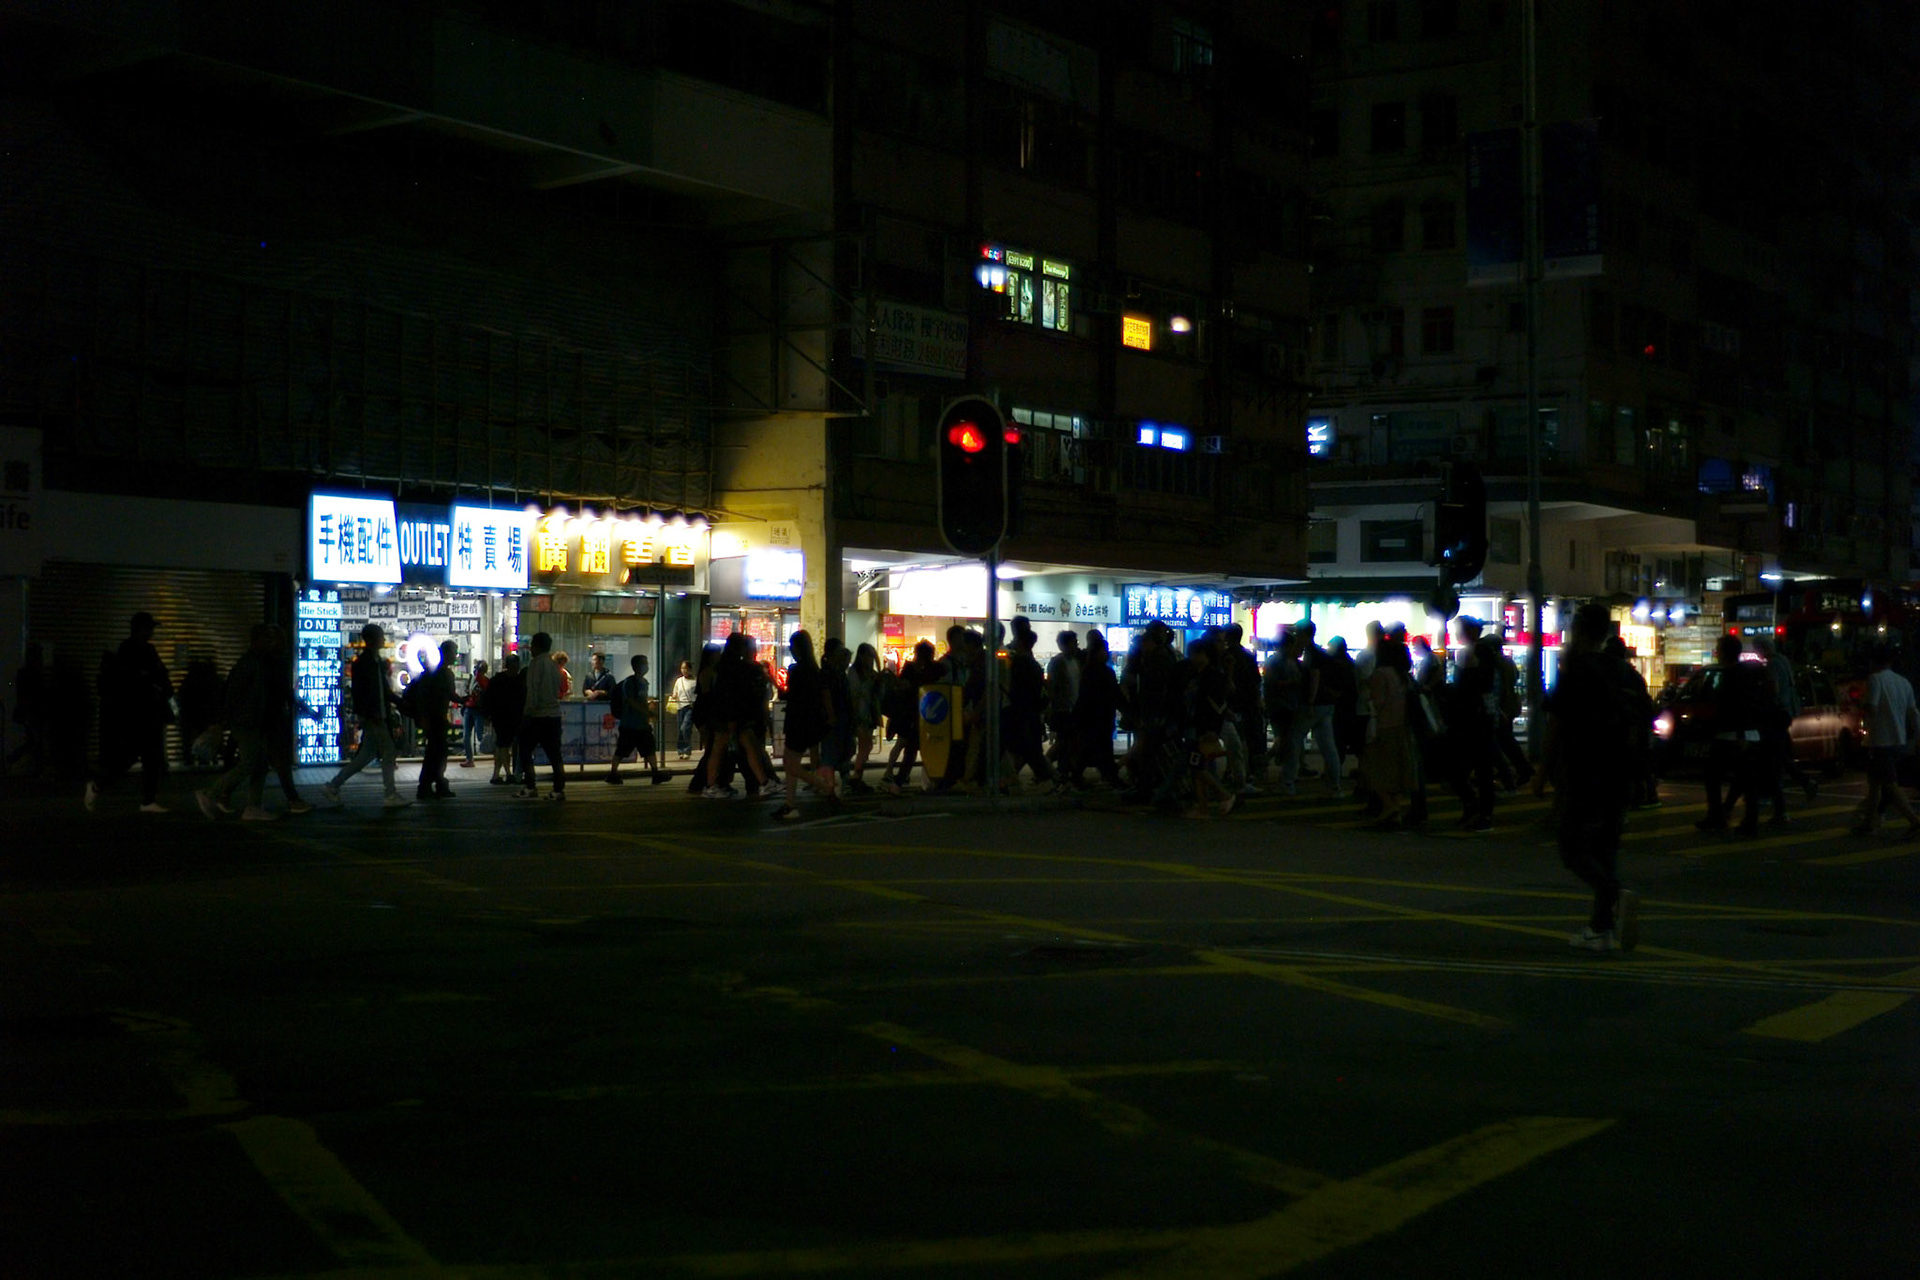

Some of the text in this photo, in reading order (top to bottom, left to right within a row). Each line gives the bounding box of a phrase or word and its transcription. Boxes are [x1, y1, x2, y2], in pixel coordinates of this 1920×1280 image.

[318, 513, 523, 574] 手機配件 OUTLET 特賣場
[299, 589, 338, 602] 電線
[317, 606, 338, 616] Stick
[1028, 603, 1037, 613] Hill
[1038, 603, 1056, 616] Bakery
[322, 635, 339, 645] Glass
